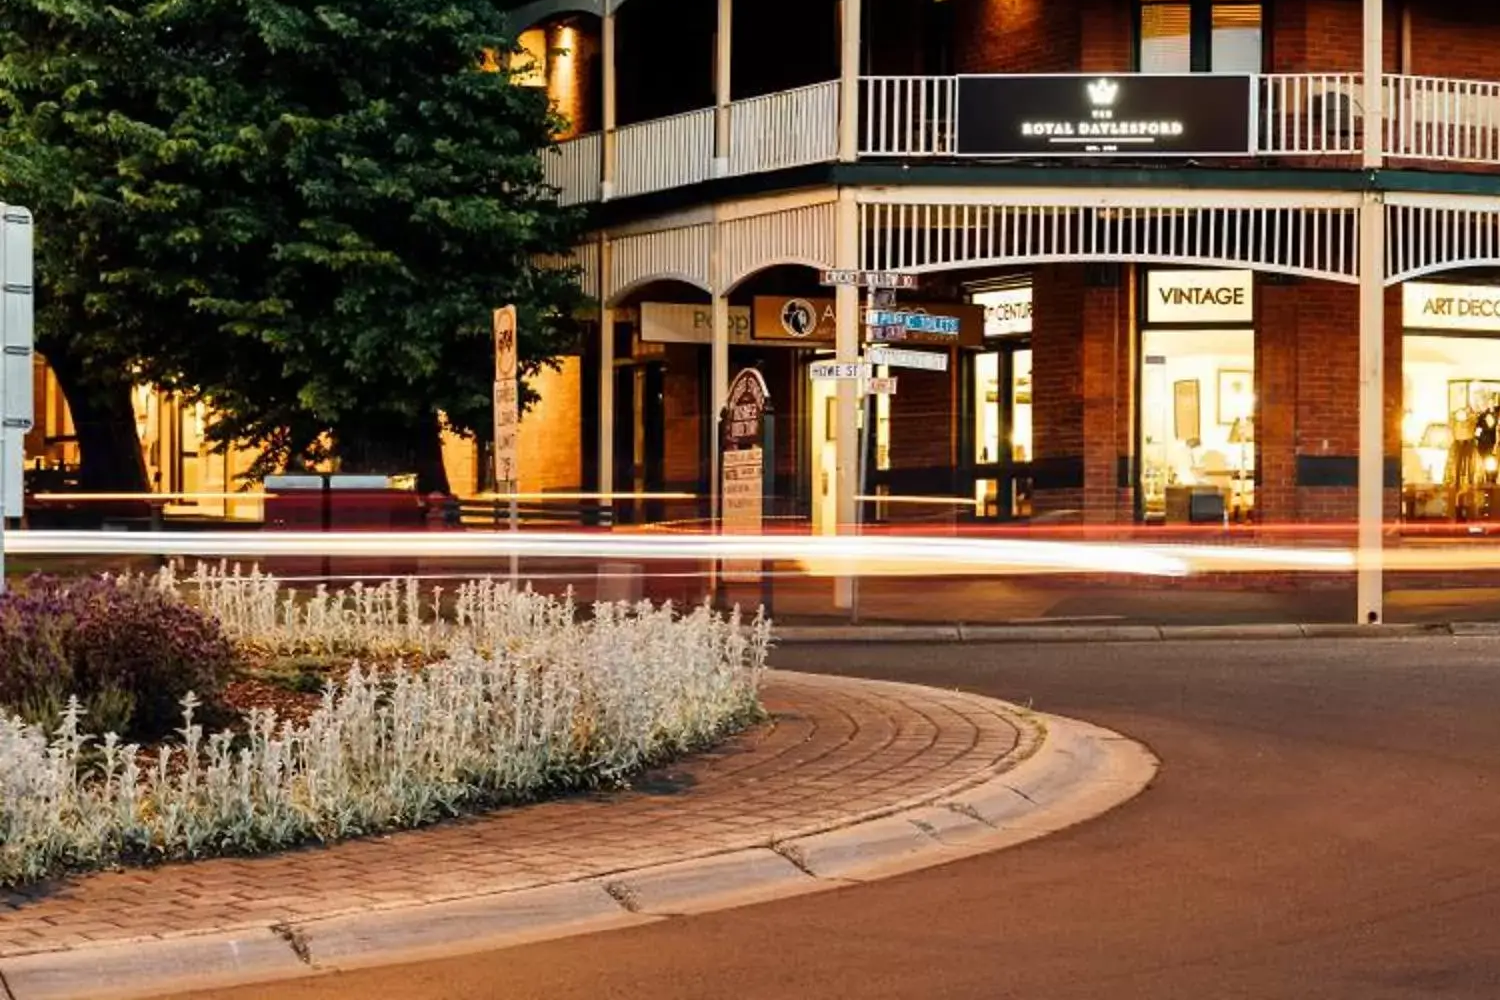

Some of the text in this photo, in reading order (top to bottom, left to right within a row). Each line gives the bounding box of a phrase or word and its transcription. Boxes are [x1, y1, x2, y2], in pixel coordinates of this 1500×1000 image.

[1022, 122, 1183, 135] ROYAL DAYLESFORD
[1159, 287, 1244, 305] VINTAGE
[1423, 298, 1454, 315] ART
